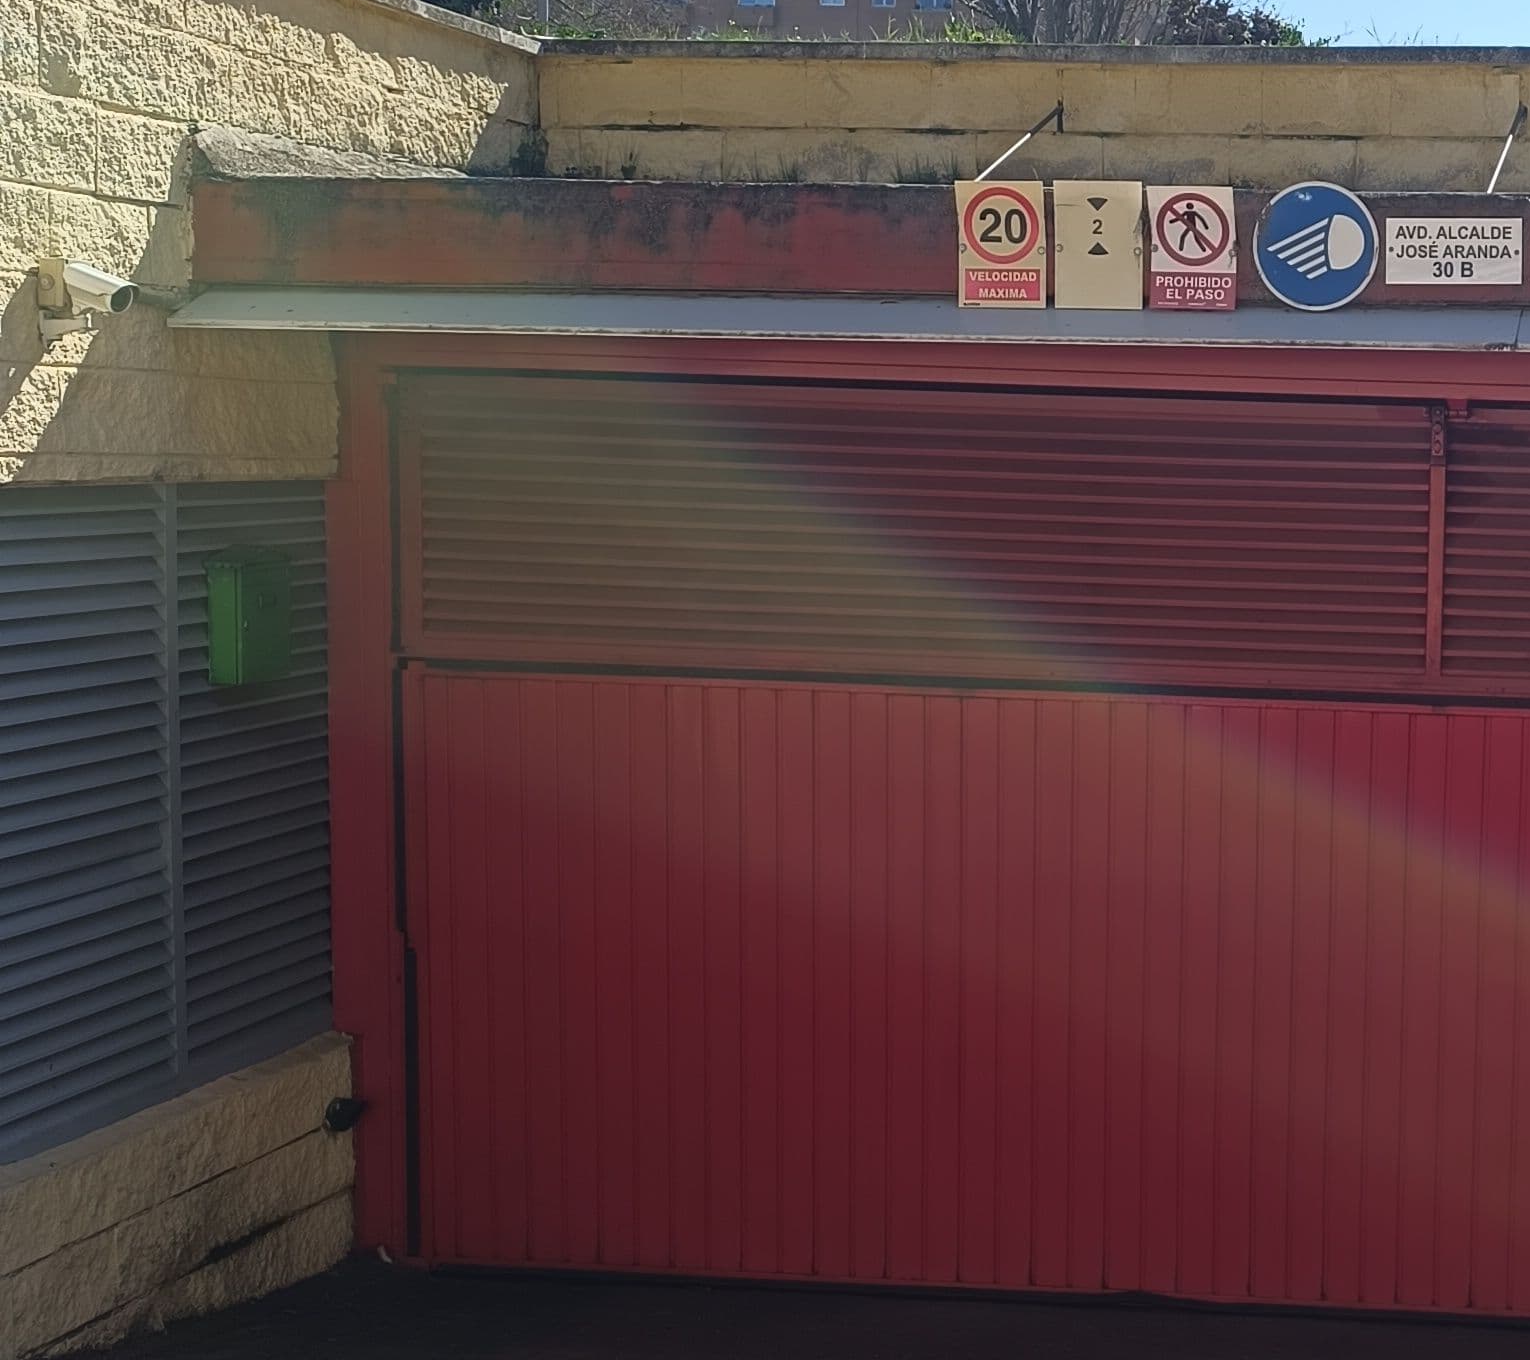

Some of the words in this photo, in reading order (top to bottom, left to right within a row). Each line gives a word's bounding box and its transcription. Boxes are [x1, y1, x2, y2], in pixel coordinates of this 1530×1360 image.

[979, 208, 1028, 244] 20
[1092, 219, 1103, 235] 2
[1395, 226, 1432, 240] AVD.
[1438, 226, 1512, 240] ALCALDE
[1396, 241, 1438, 259] JOSÉ
[1442, 245, 1512, 259] ARANDA
[969, 271, 1037, 282] VELOCIDAD
[1432, 262, 1454, 278] 30
[1460, 262, 1474, 278] B
[1155, 276, 1232, 288] PROHIBIDO
[978, 288, 1028, 299] MAXIMA
[1165, 289, 1182, 299] EL
[1186, 289, 1225, 301] PASO
